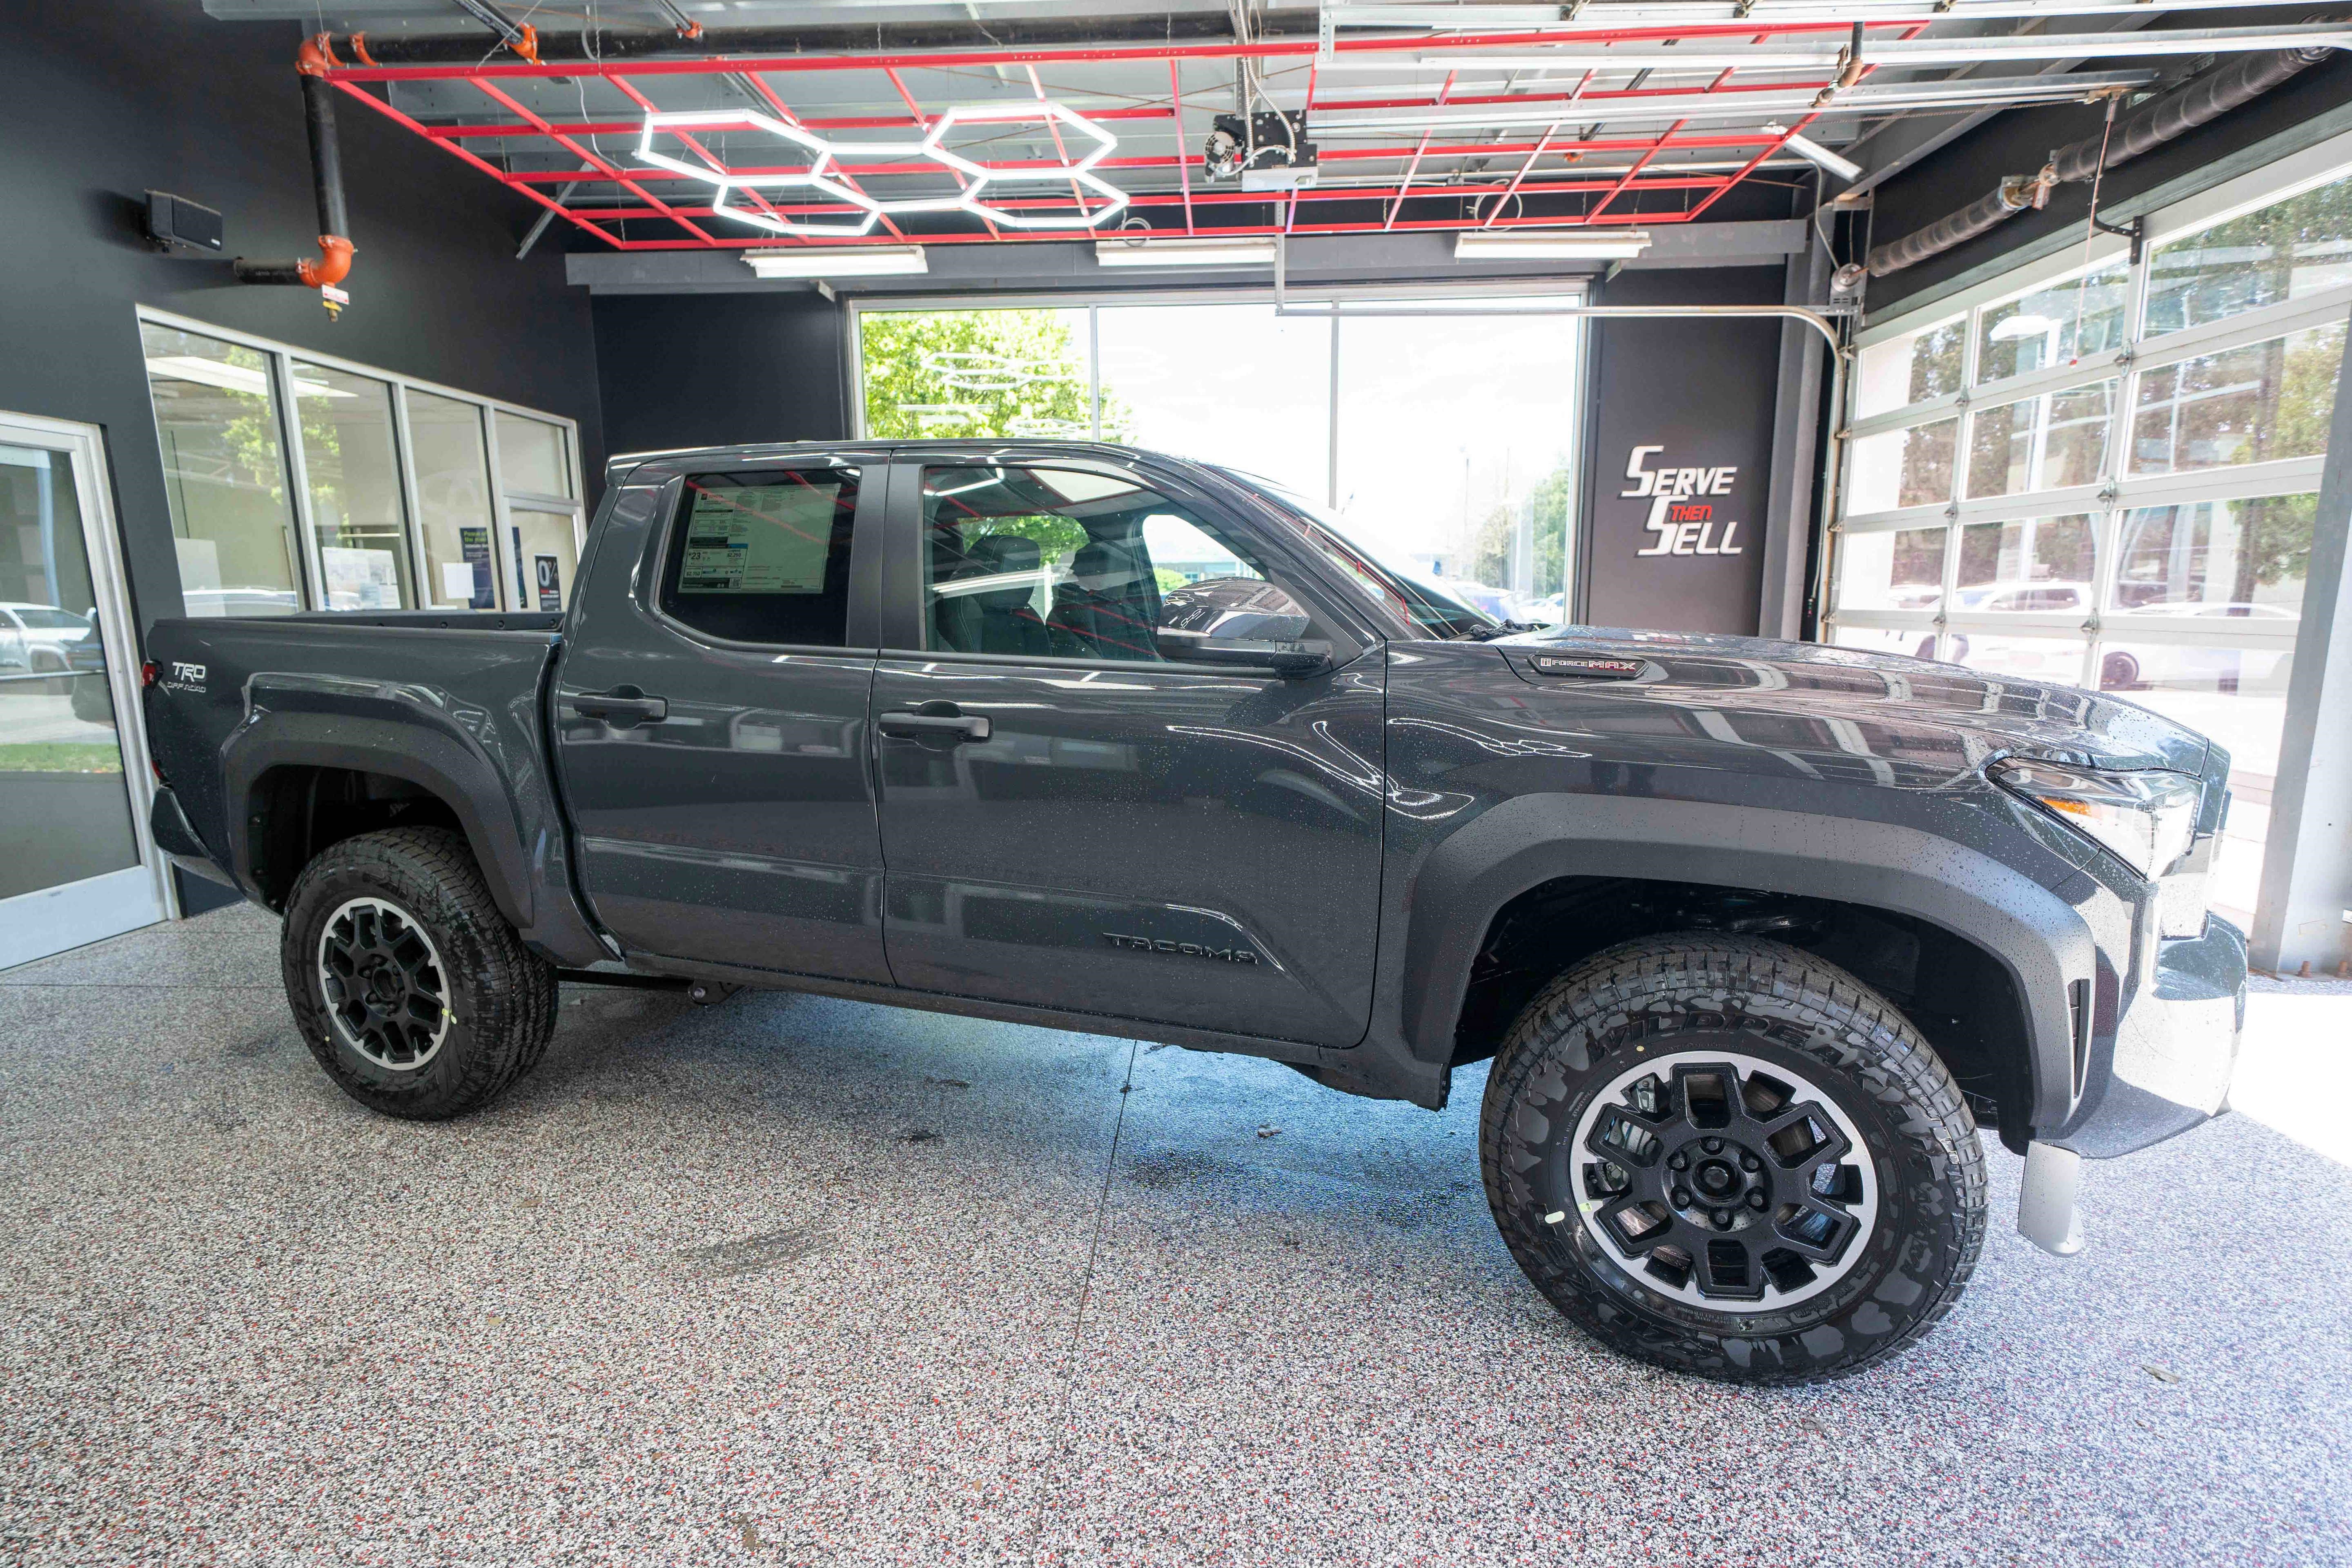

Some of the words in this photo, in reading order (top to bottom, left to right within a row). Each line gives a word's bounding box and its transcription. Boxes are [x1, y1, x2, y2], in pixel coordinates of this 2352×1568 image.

[1620, 445, 1737, 497] SERVE
[1637, 495, 1743, 556] SELL
[1671, 505, 1712, 521] THEN
[537, 560, 559, 587] 0%
[172, 662, 206, 682] TRD
[1102, 932, 1259, 965] TACOMA
